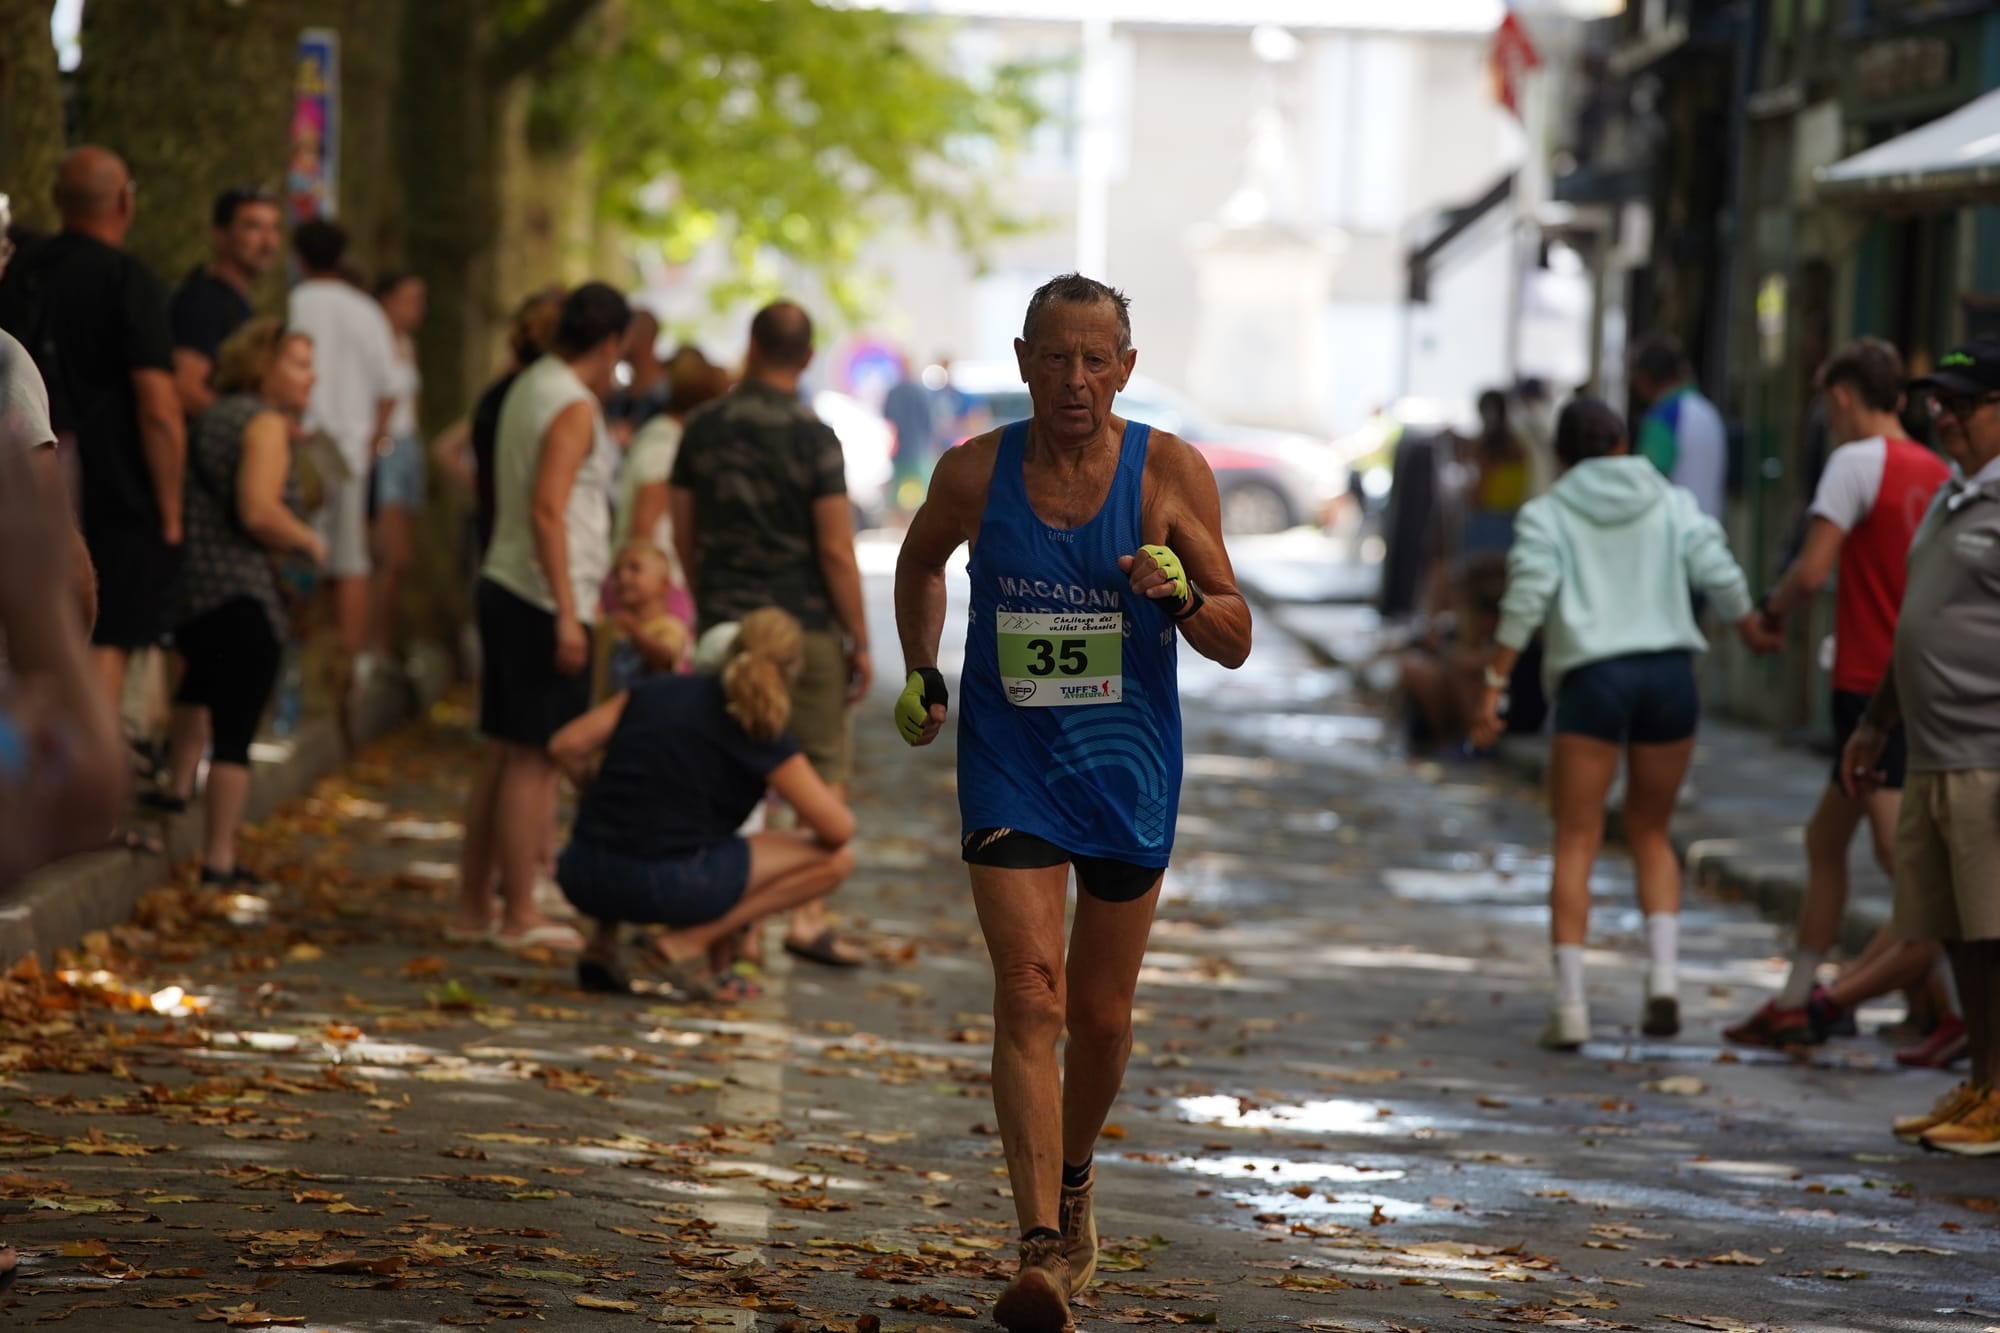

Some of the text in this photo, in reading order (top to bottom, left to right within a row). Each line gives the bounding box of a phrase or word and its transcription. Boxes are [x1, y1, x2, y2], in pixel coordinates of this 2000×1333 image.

[998, 576, 1120, 609] MACADAM
[1053, 615, 1113, 626] Challenge des
[1027, 638, 1088, 676] 35
[1060, 685, 1098, 695] TUFF'S
[1063, 691, 1102, 700] Aventure
